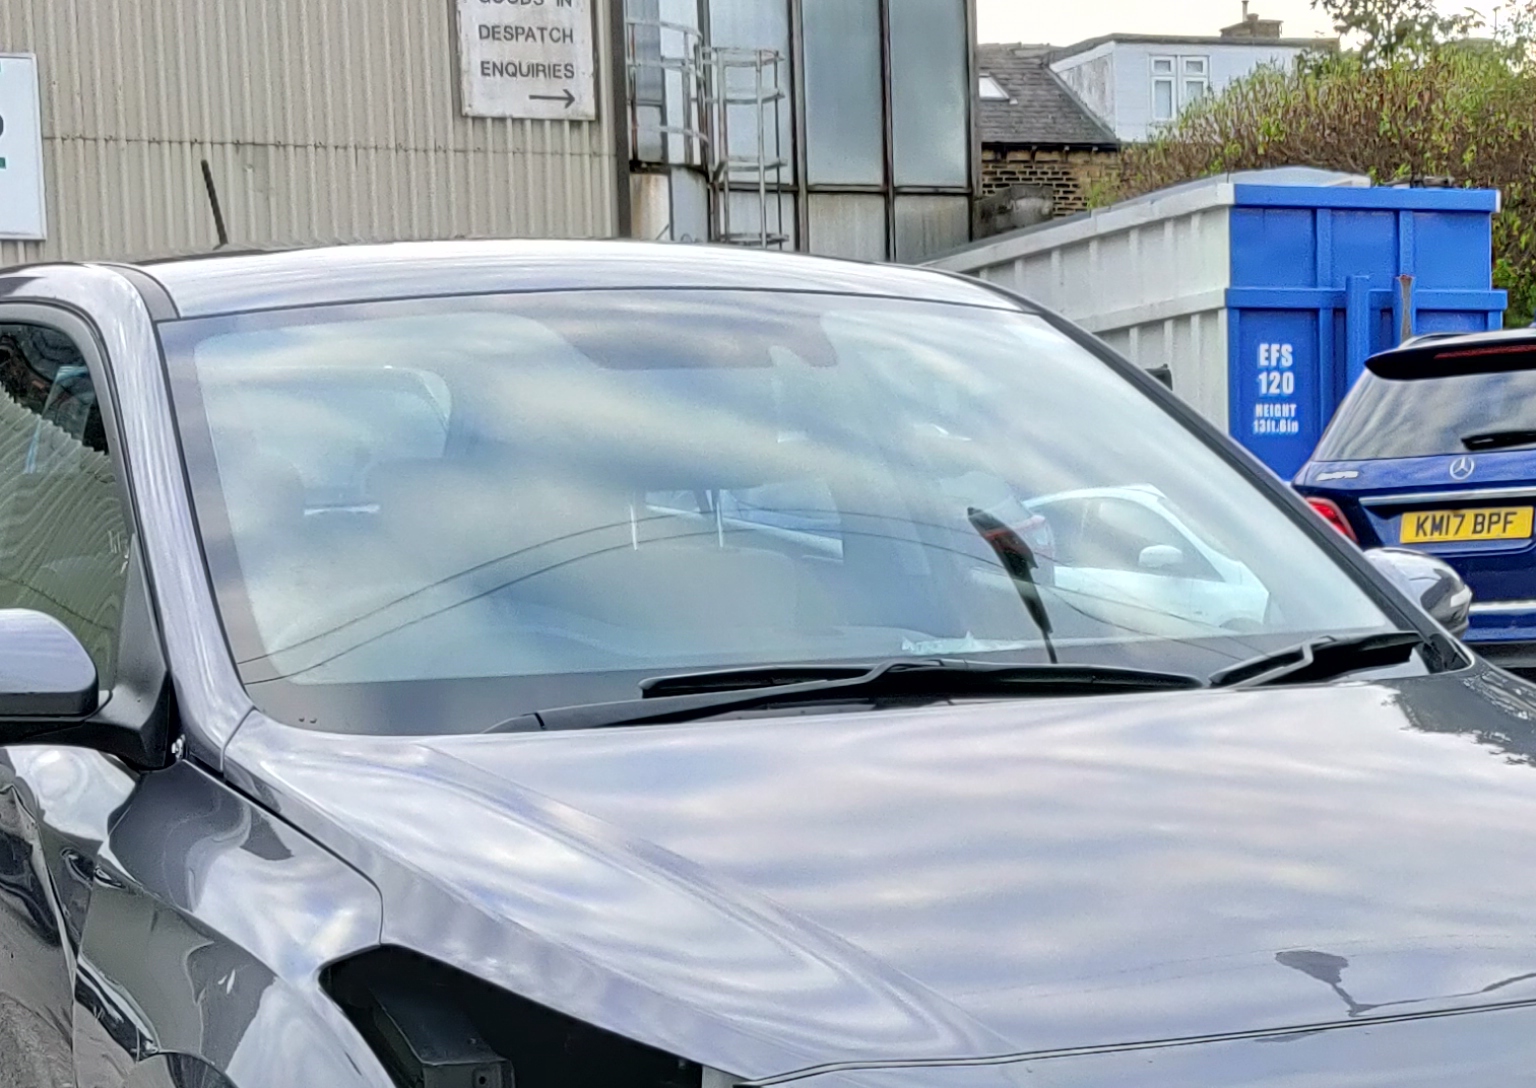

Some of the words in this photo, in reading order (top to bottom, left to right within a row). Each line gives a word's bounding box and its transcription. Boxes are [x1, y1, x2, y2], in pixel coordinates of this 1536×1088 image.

[478, 24, 574, 43] DESPATCH
[479, 61, 575, 80] ENQUIRIES
[1258, 343, 1293, 368] EFS
[1258, 370, 1294, 395] 120
[1255, 403, 1297, 418] HEIGHT
[1415, 513, 1466, 538] KM17
[1471, 511, 1518, 535] BPF
